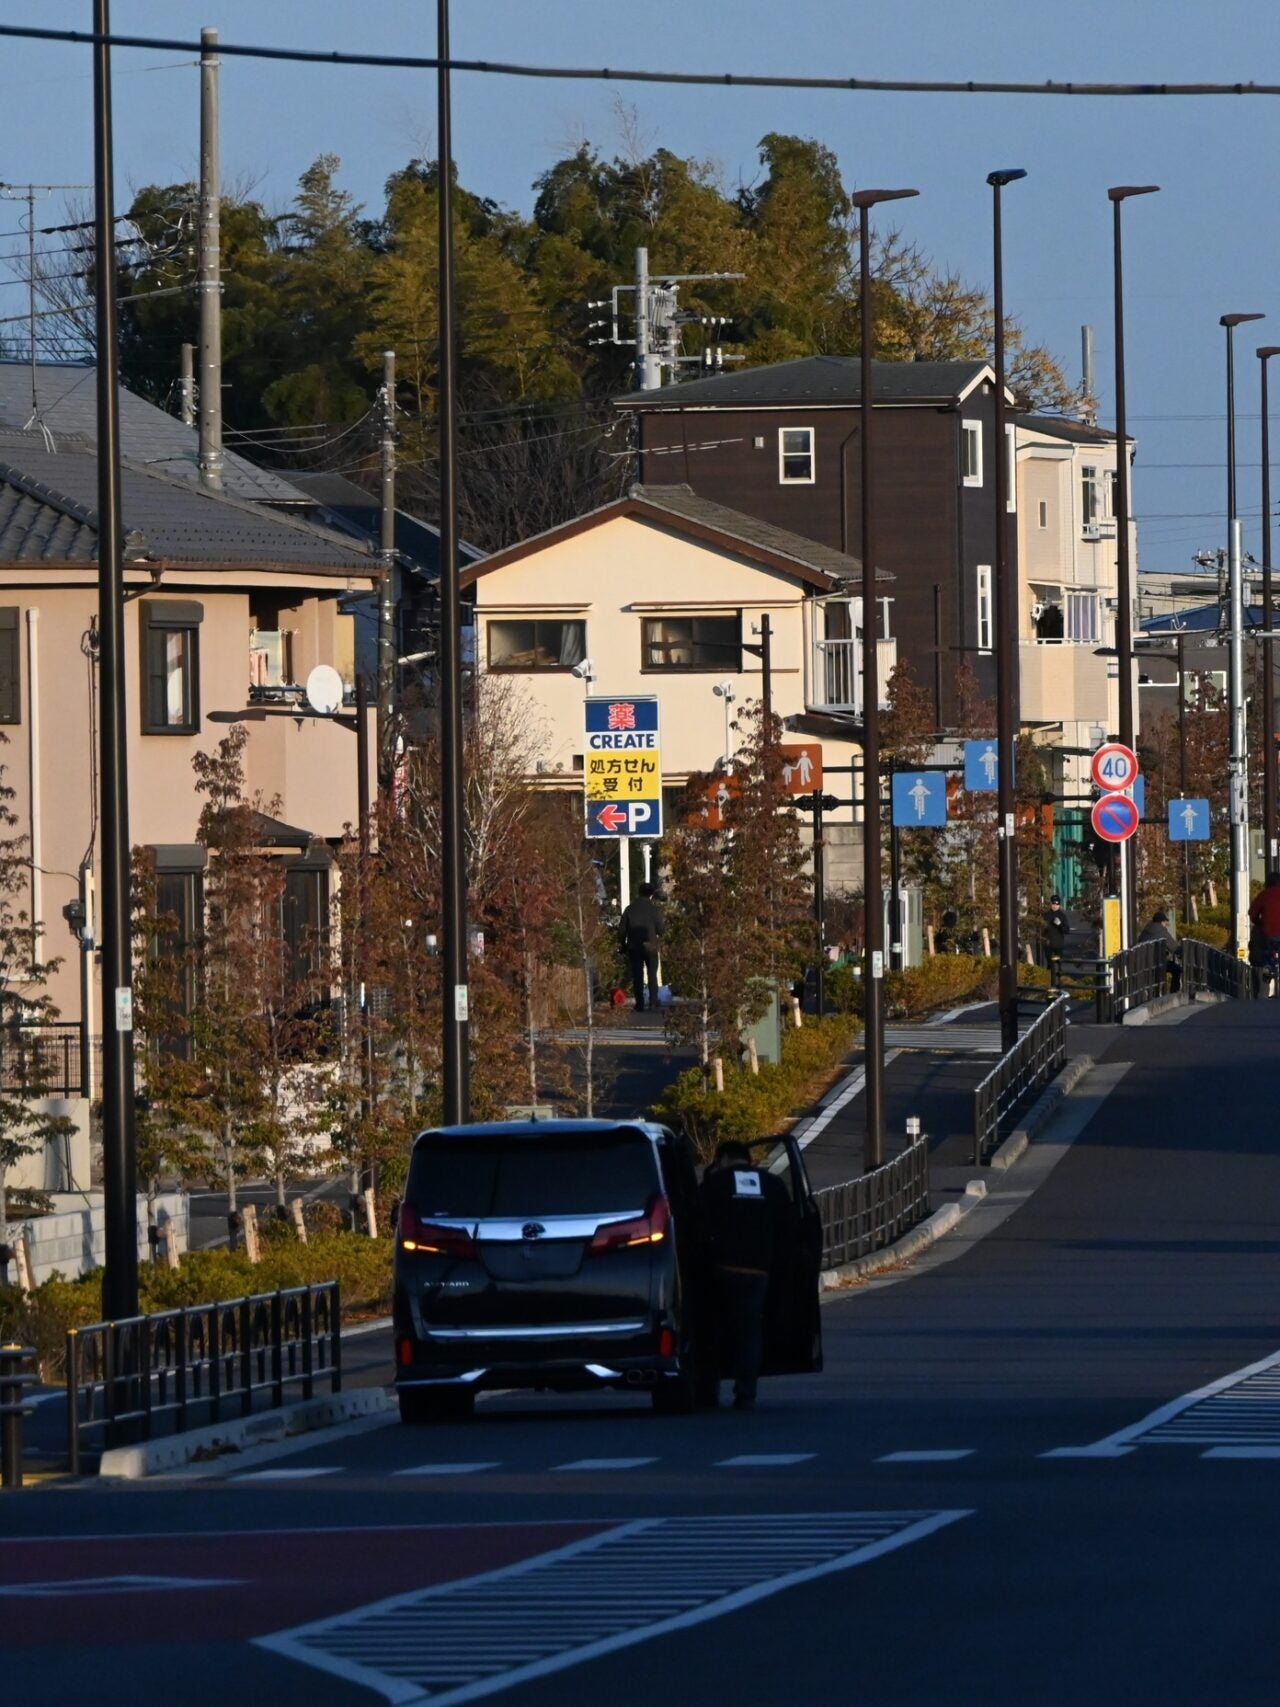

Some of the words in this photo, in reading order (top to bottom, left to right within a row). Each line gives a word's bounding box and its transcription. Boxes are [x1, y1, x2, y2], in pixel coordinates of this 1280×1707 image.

[608, 703, 636, 730] 薬
[590, 734, 655, 749] CREATE
[590, 759, 656, 774] 処方せん
[1102, 757, 1127, 778] 40
[603, 777, 643, 792] 受付
[628, 802, 652, 833] P
